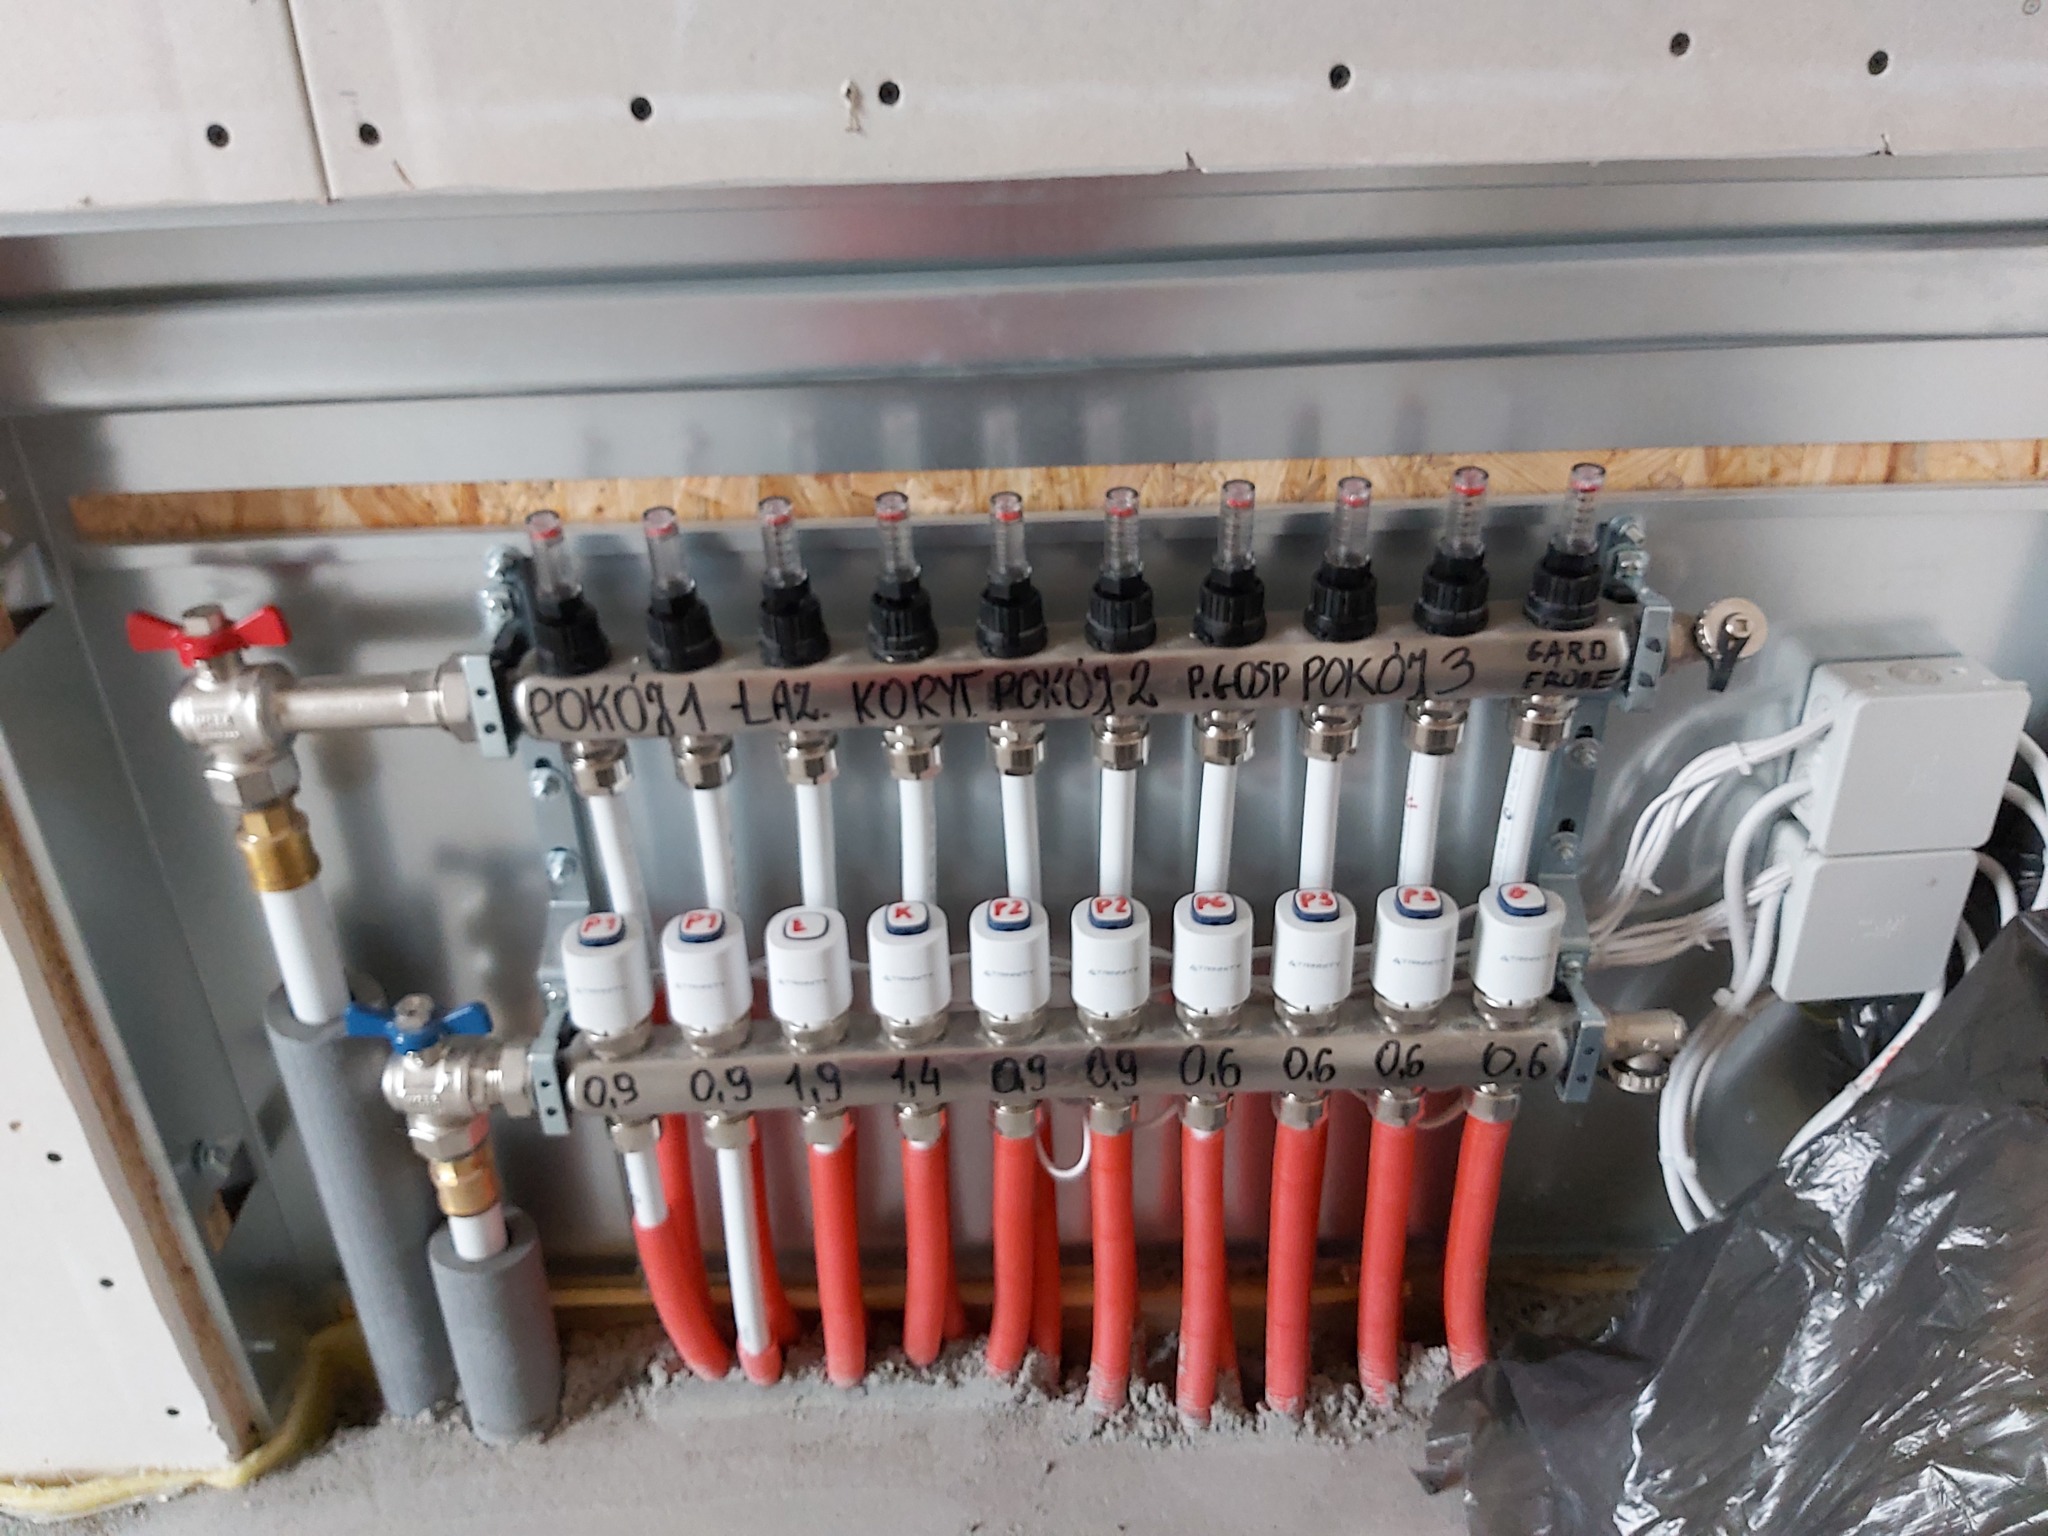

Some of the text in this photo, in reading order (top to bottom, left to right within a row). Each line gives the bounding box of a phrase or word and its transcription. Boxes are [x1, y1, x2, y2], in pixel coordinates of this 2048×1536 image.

[1434, 646, 1476, 696] 3
[1127, 658, 1159, 708] 2
[993, 899, 1025, 917] P2
[1094, 895, 1128, 914] P2
[1299, 891, 1334, 908] P3
[894, 905, 913, 919] K
